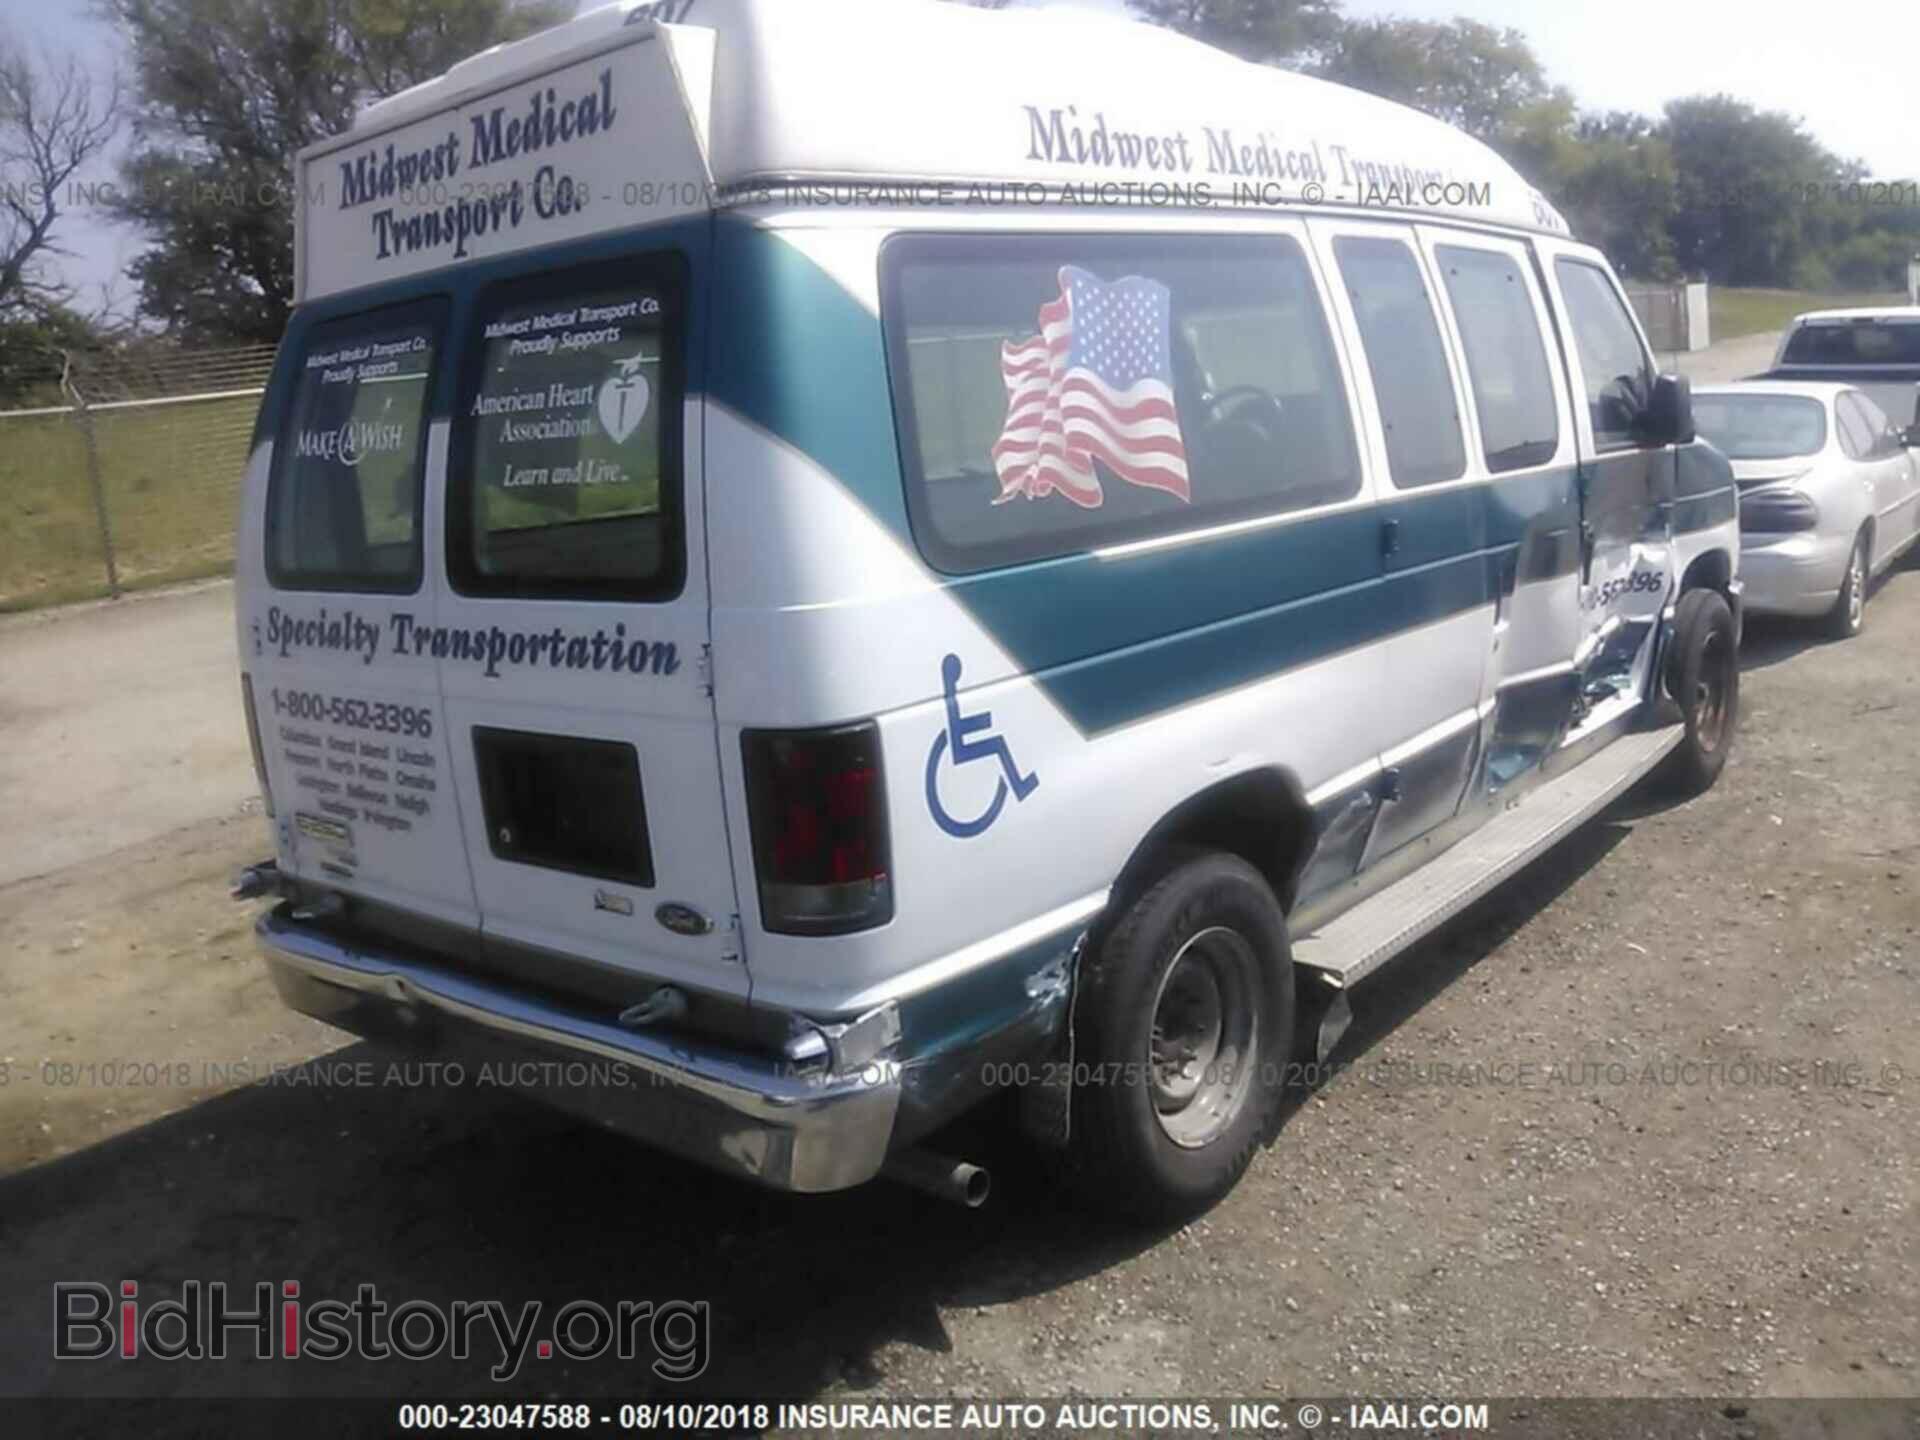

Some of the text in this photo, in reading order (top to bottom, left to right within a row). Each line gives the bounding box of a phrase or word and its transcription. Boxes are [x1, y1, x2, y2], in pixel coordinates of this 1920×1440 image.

[339, 67, 616, 211] Midwest Medical
[1022, 104, 1193, 173] Midwest
[1202, 126, 1328, 182] Medical
[372, 164, 583, 260] Transport Co.
[484, 318, 530, 338] Midwest
[532, 309, 577, 330] Medical
[579, 301, 638, 324] Transport
[510, 326, 621, 355] Proudly Supports
[470, 383, 595, 416] American Heart
[499, 412, 592, 443] Association
[503, 464, 549, 487] Learn
[551, 460, 583, 484] and
[267, 605, 681, 678] Specialty Transportation
[271, 687, 433, 739] 1-800-562-3396
